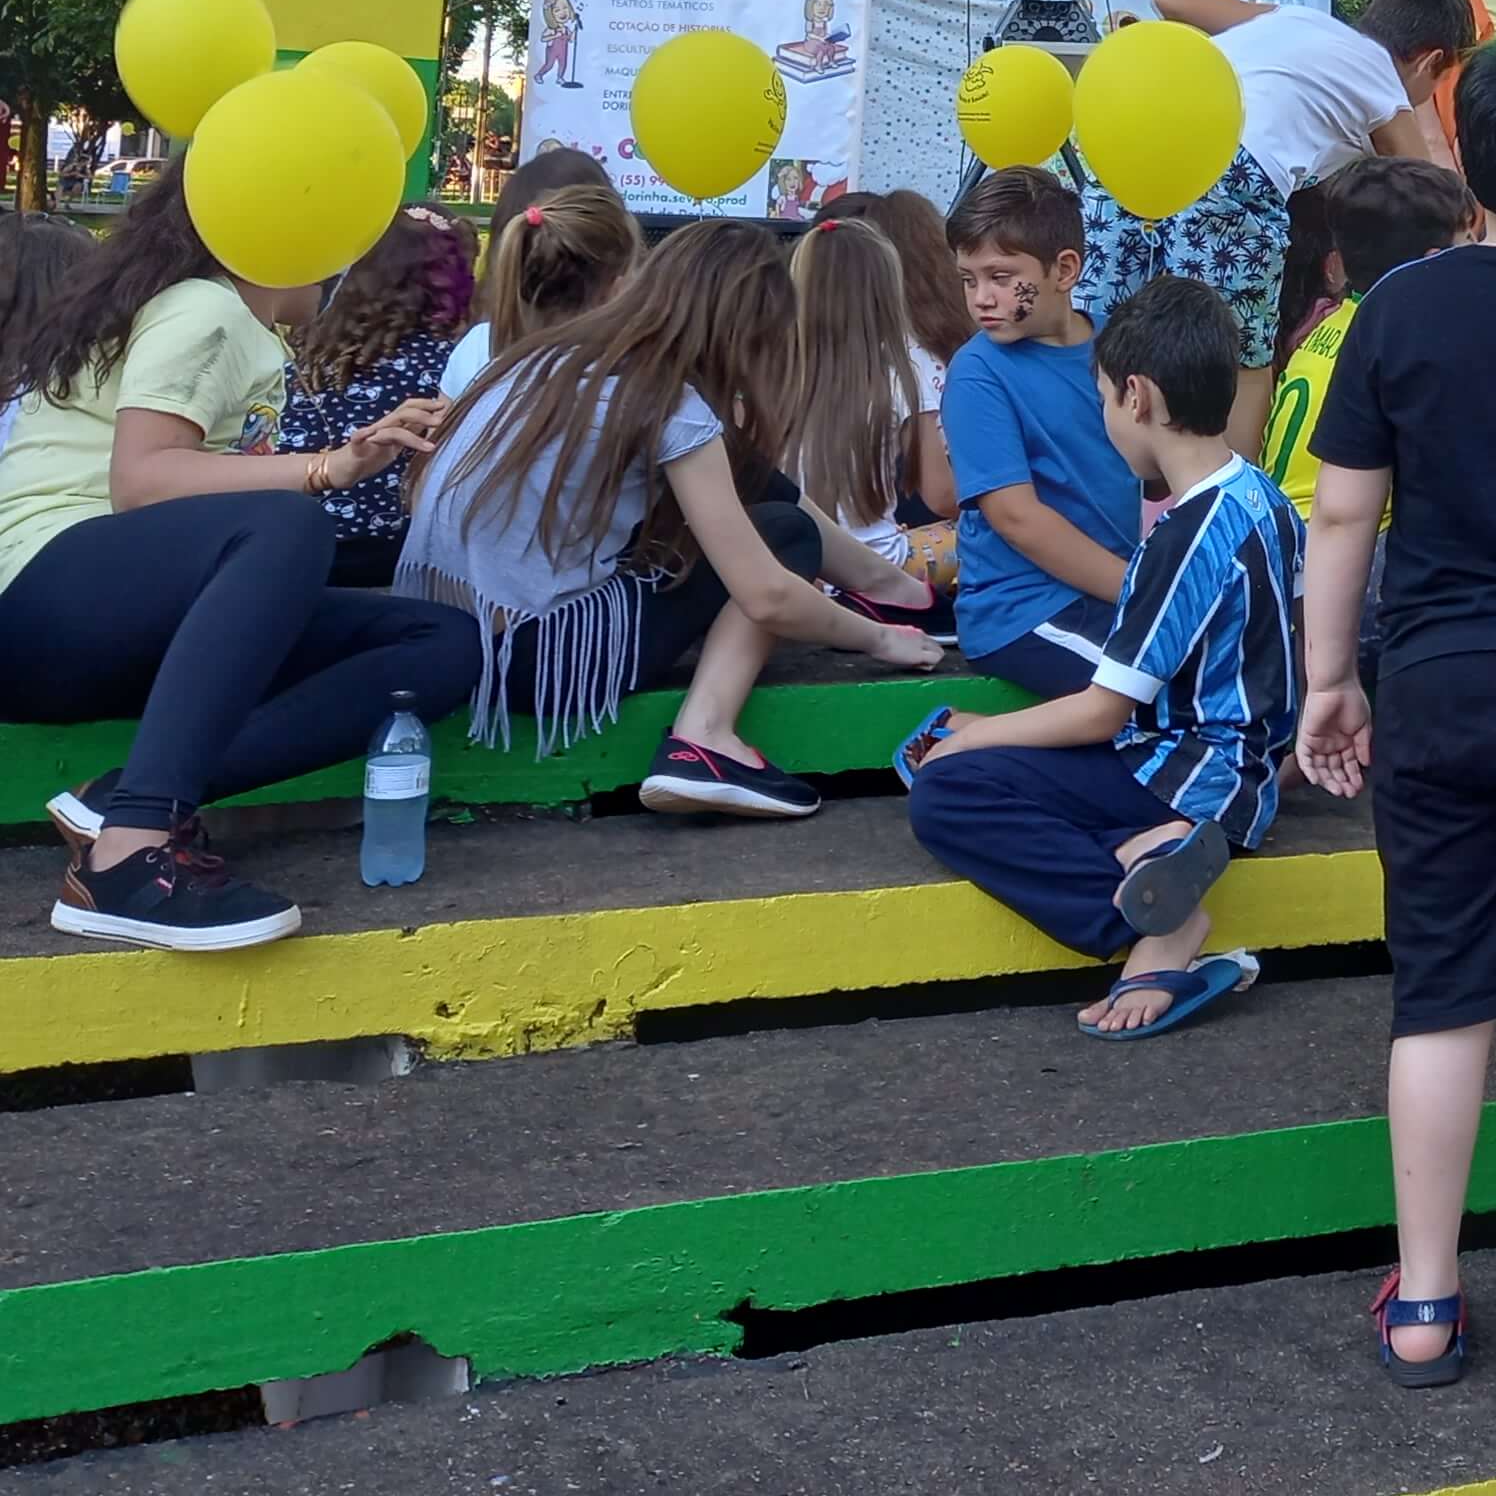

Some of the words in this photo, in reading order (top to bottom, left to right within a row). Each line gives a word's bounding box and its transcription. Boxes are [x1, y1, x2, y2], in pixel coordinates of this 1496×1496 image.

[662, 23, 676, 33] DE
[606, 43, 656, 56] ESCULTU
[604, 66, 641, 78] MAQU
[619, 174, 646, 188] (55)
